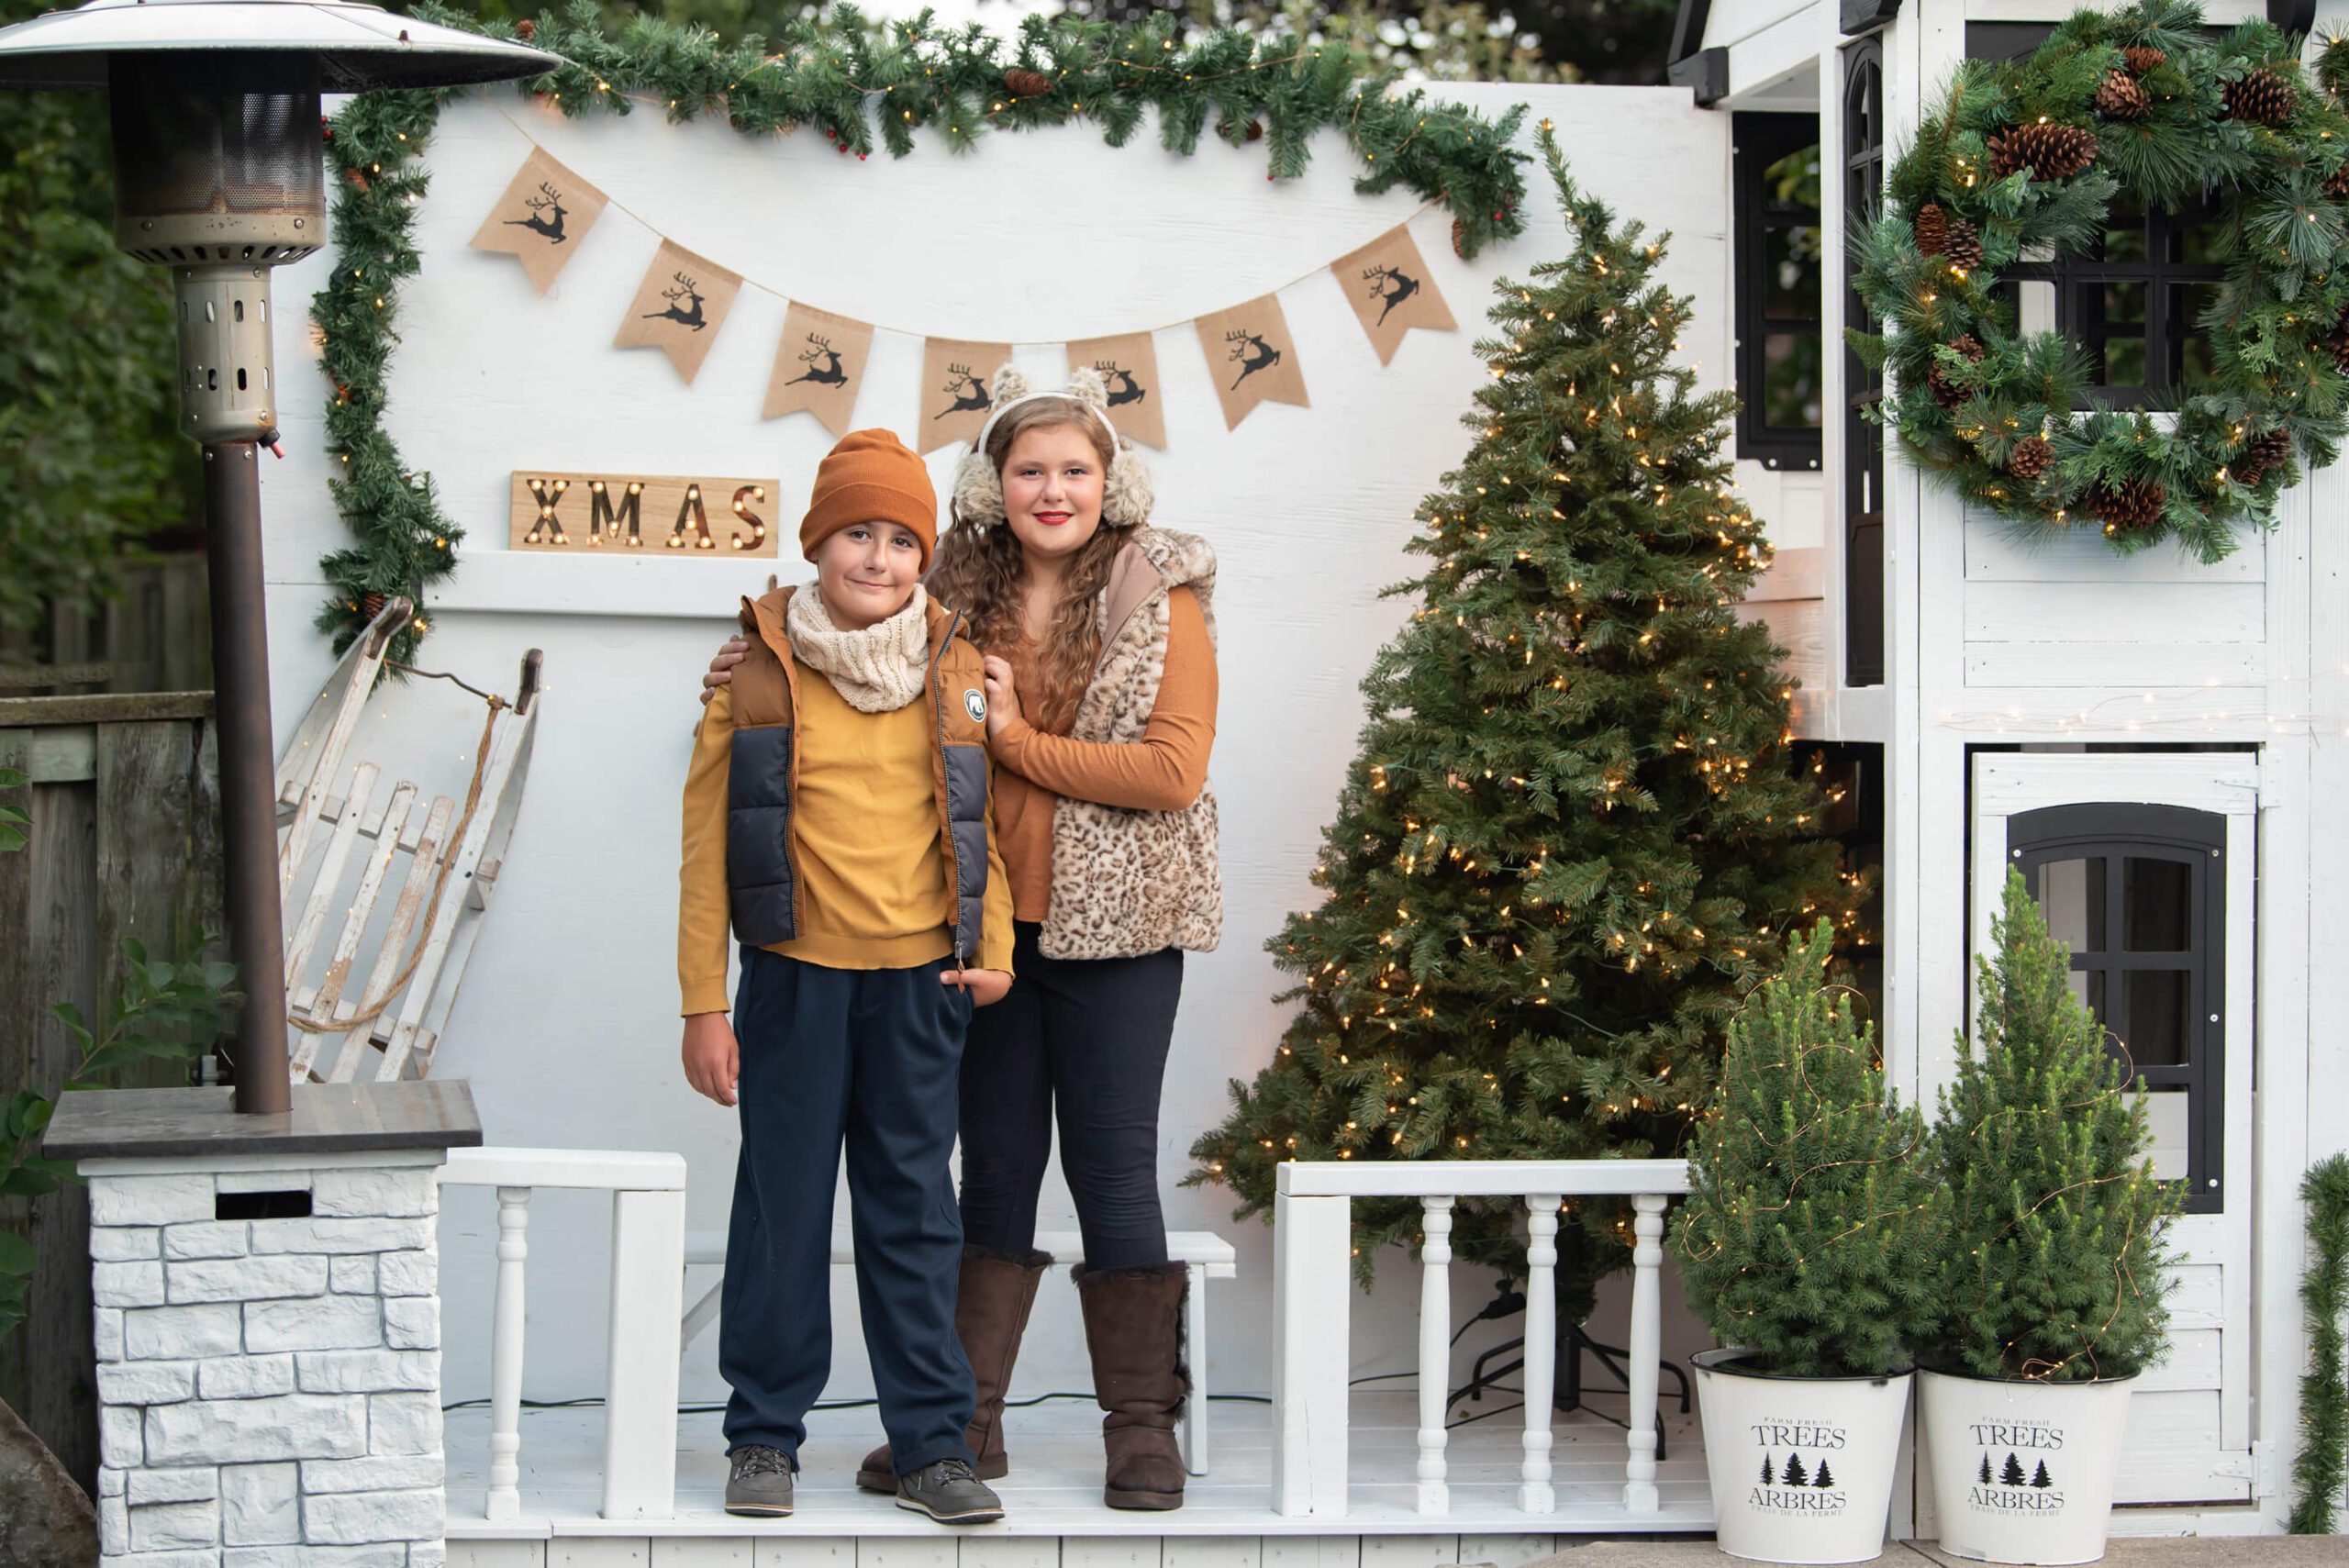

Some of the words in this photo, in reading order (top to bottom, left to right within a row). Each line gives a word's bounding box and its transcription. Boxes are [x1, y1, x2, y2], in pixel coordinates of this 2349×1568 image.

[524, 479, 765, 550] XMAS
[1765, 1417, 1793, 1425] FARM
[1982, 1416, 2010, 1425] FARM
[1751, 1425, 1846, 1450] TREES
[1969, 1424, 2064, 1450] TREES
[1748, 1487, 1847, 1510] ARBRES
[1967, 1486, 2065, 1510] ARBRES
[1812, 1509, 1842, 1518] FERME
[2014, 1509, 2025, 1518] LA
